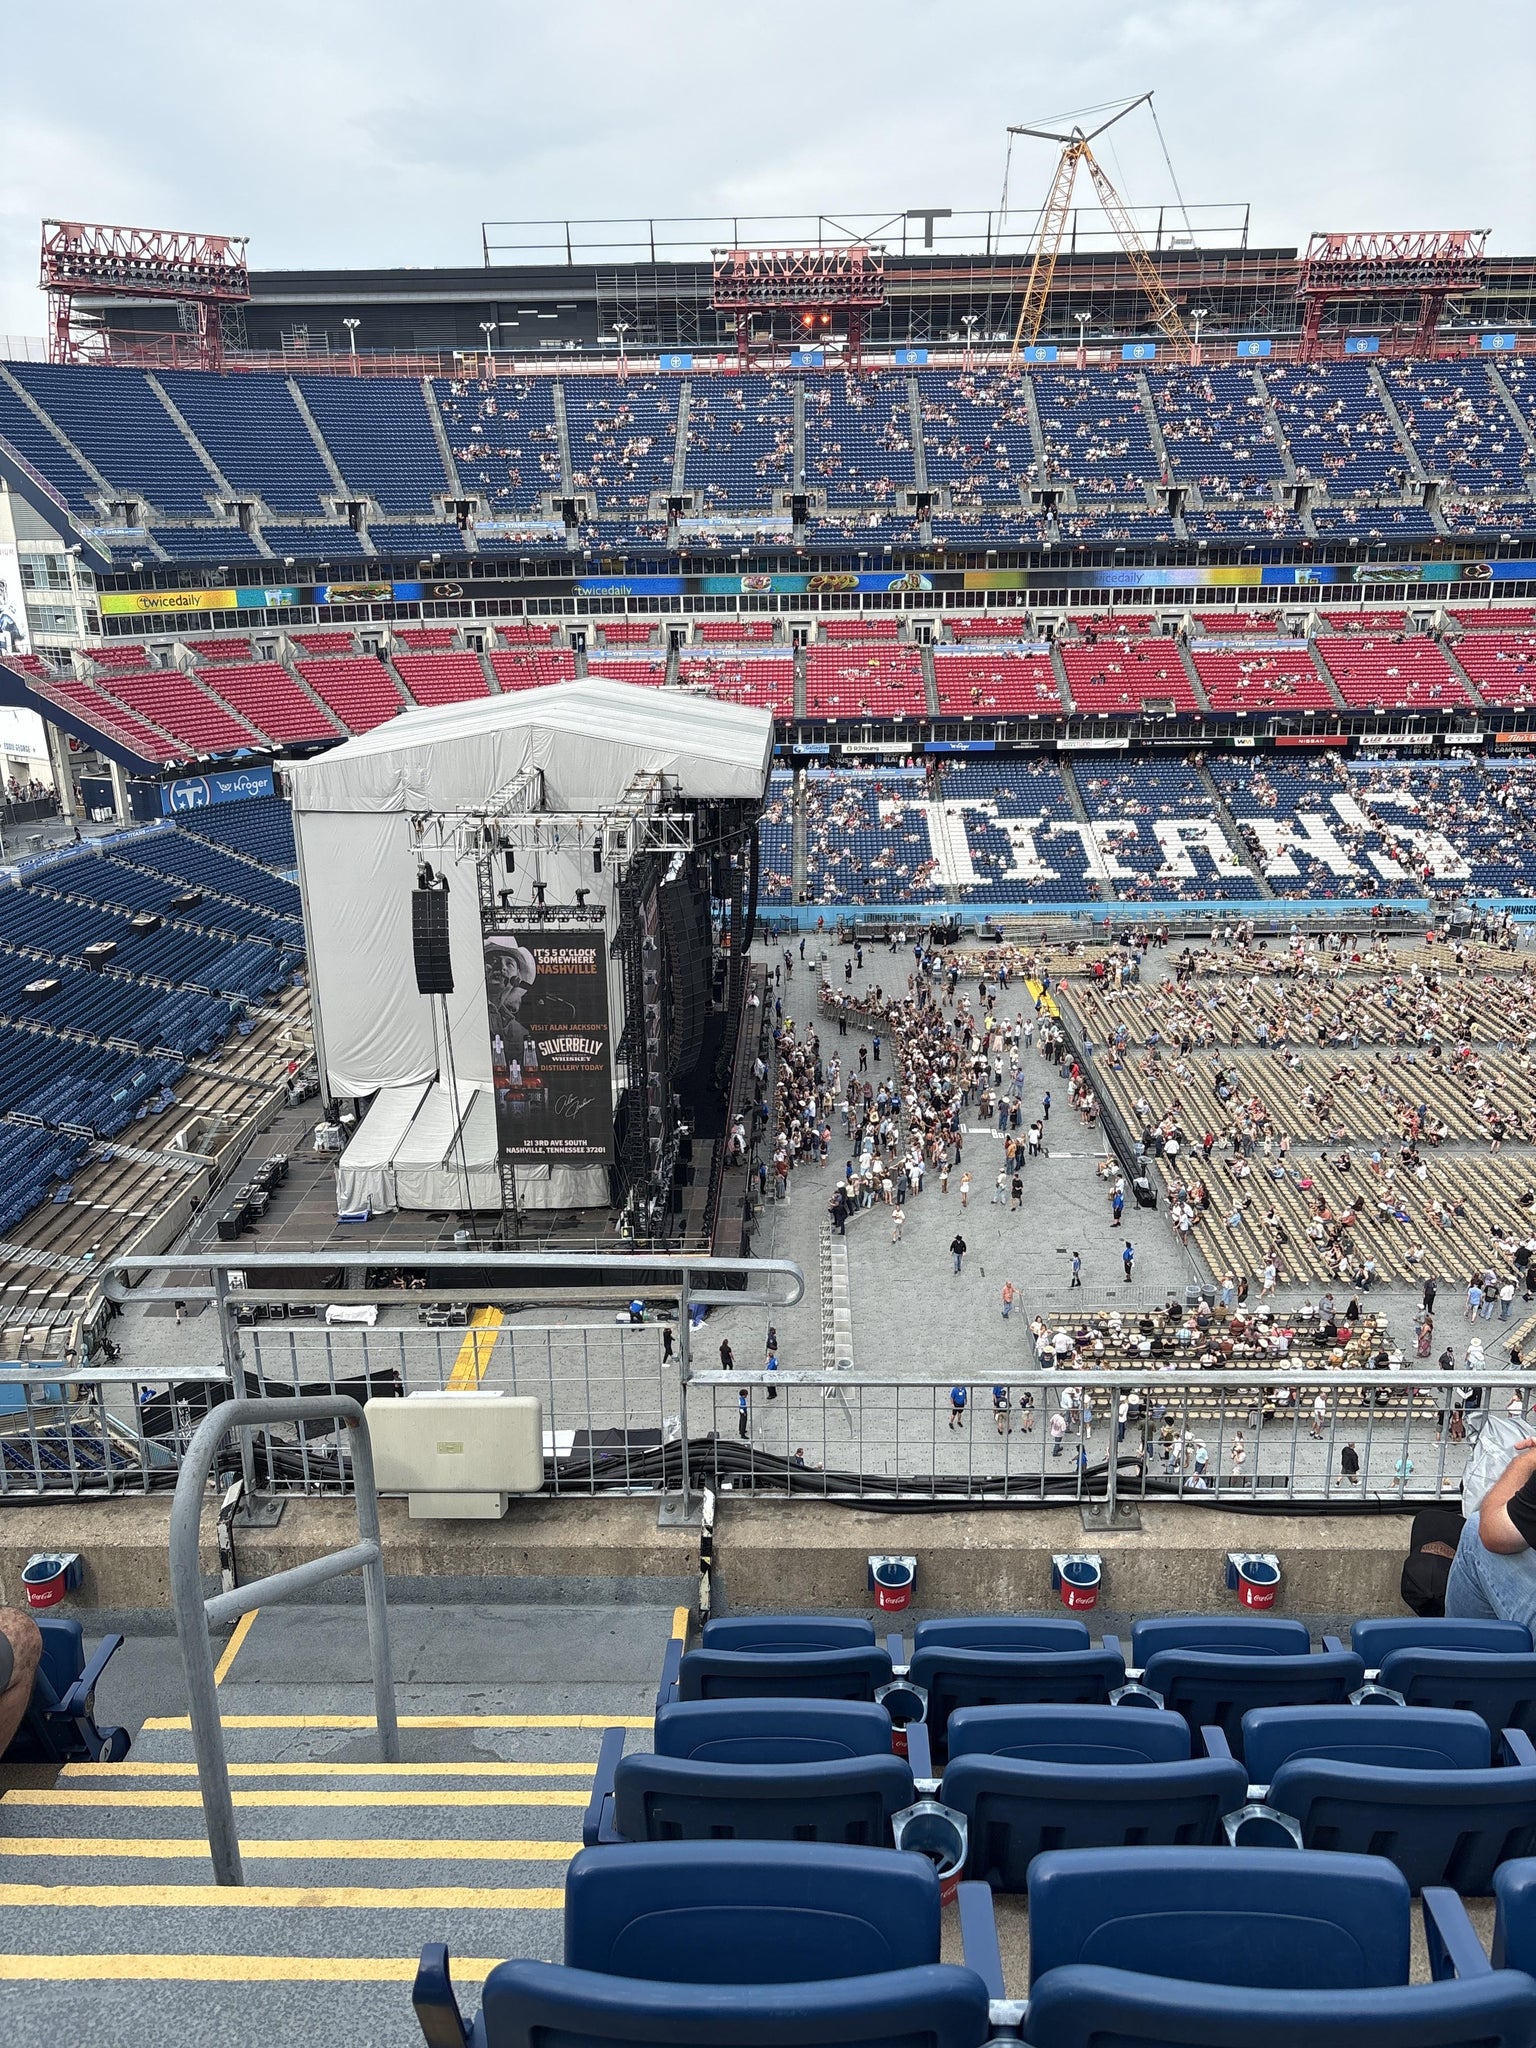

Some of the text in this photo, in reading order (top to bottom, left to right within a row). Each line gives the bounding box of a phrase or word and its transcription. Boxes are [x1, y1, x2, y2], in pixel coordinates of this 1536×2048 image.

[907, 209, 952, 248] T
[575, 585, 632, 596] twicedaily
[142, 595, 201, 609] twicedaily
[233, 775, 269, 796] Kroger
[533, 948, 597, 957] IT'S 5 O'CLOCK
[538, 956, 595, 964] SOMEWHERE
[536, 964, 598, 974] NASHVILLE
[568, 1023, 608, 1031] JACKSON'S
[538, 1037, 603, 1056] SILVERBELLY
[540, 1064, 580, 1072] DISTILLERY
[505, 1146, 606, 1154] NASHVILLE, TENNESSEE 37201
